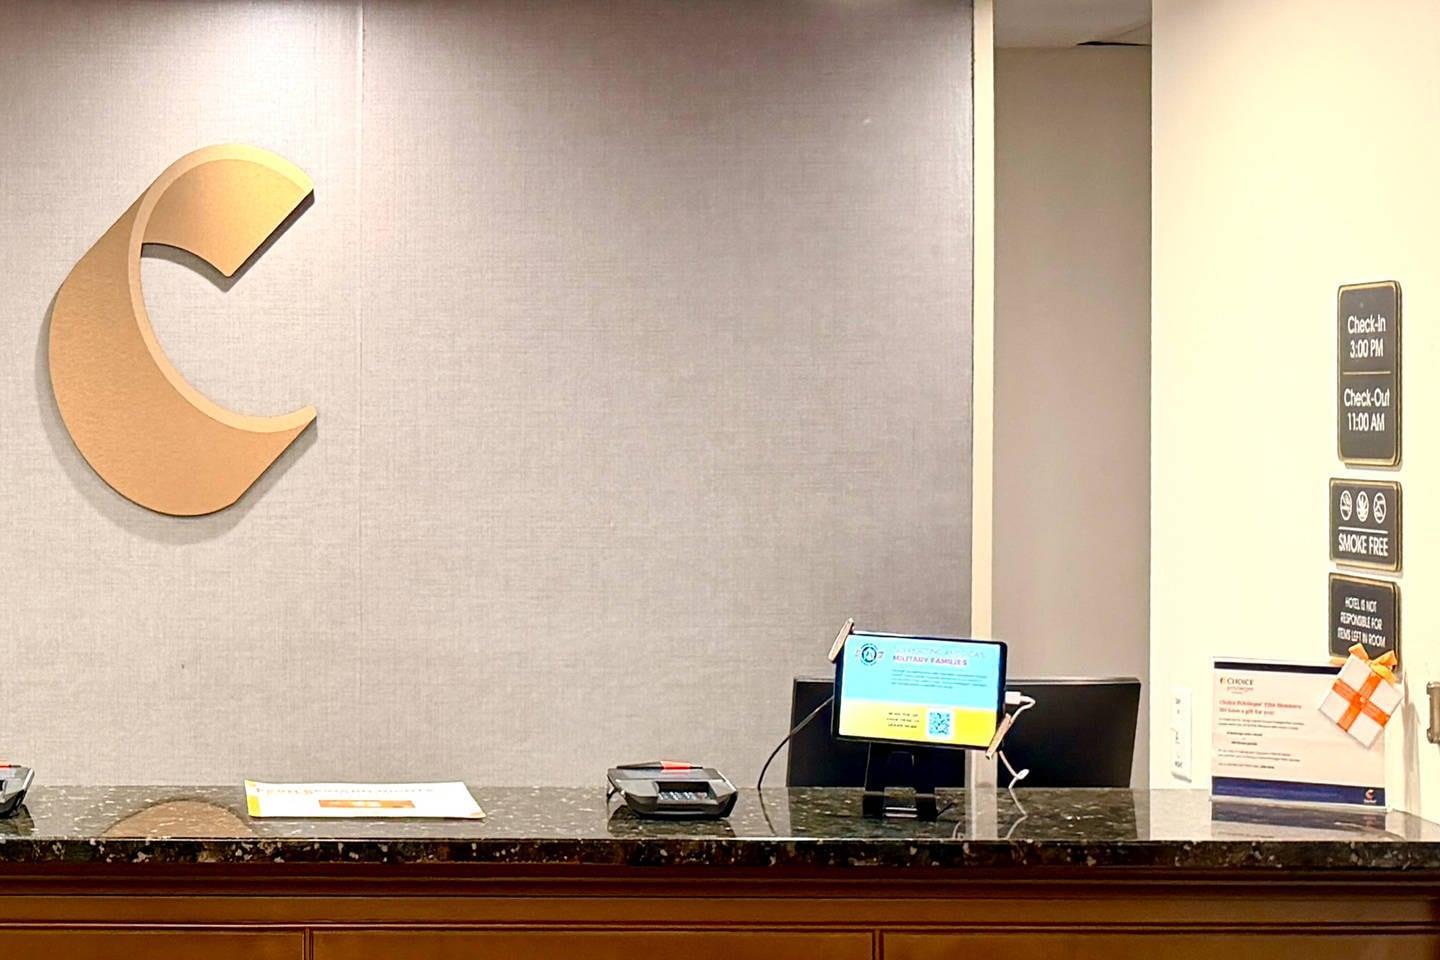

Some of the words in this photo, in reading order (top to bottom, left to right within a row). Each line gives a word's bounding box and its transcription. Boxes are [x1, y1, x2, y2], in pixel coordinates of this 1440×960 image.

[1347, 314, 1386, 334] Check-In
[1350, 339, 1369, 358] 3:00
[1370, 338, 1384, 357] PM
[1344, 388, 1390, 407] Check-Out
[1347, 412, 1369, 431] 11:00
[1370, 413, 1385, 431] AM
[1338, 533, 1367, 554] SMOKE
[1369, 536, 1388, 557] FREE
[1345, 596, 1360, 610] HOTEL
[1366, 600, 1377, 613] NOT
[1340, 611, 1370, 628] RESPONSIBLE
[1371, 616, 1383, 630] FOR
[1337, 627, 1350, 641] ITEMS
[1351, 630, 1361, 642] LEFT
[1369, 633, 1386, 648] ROOM
